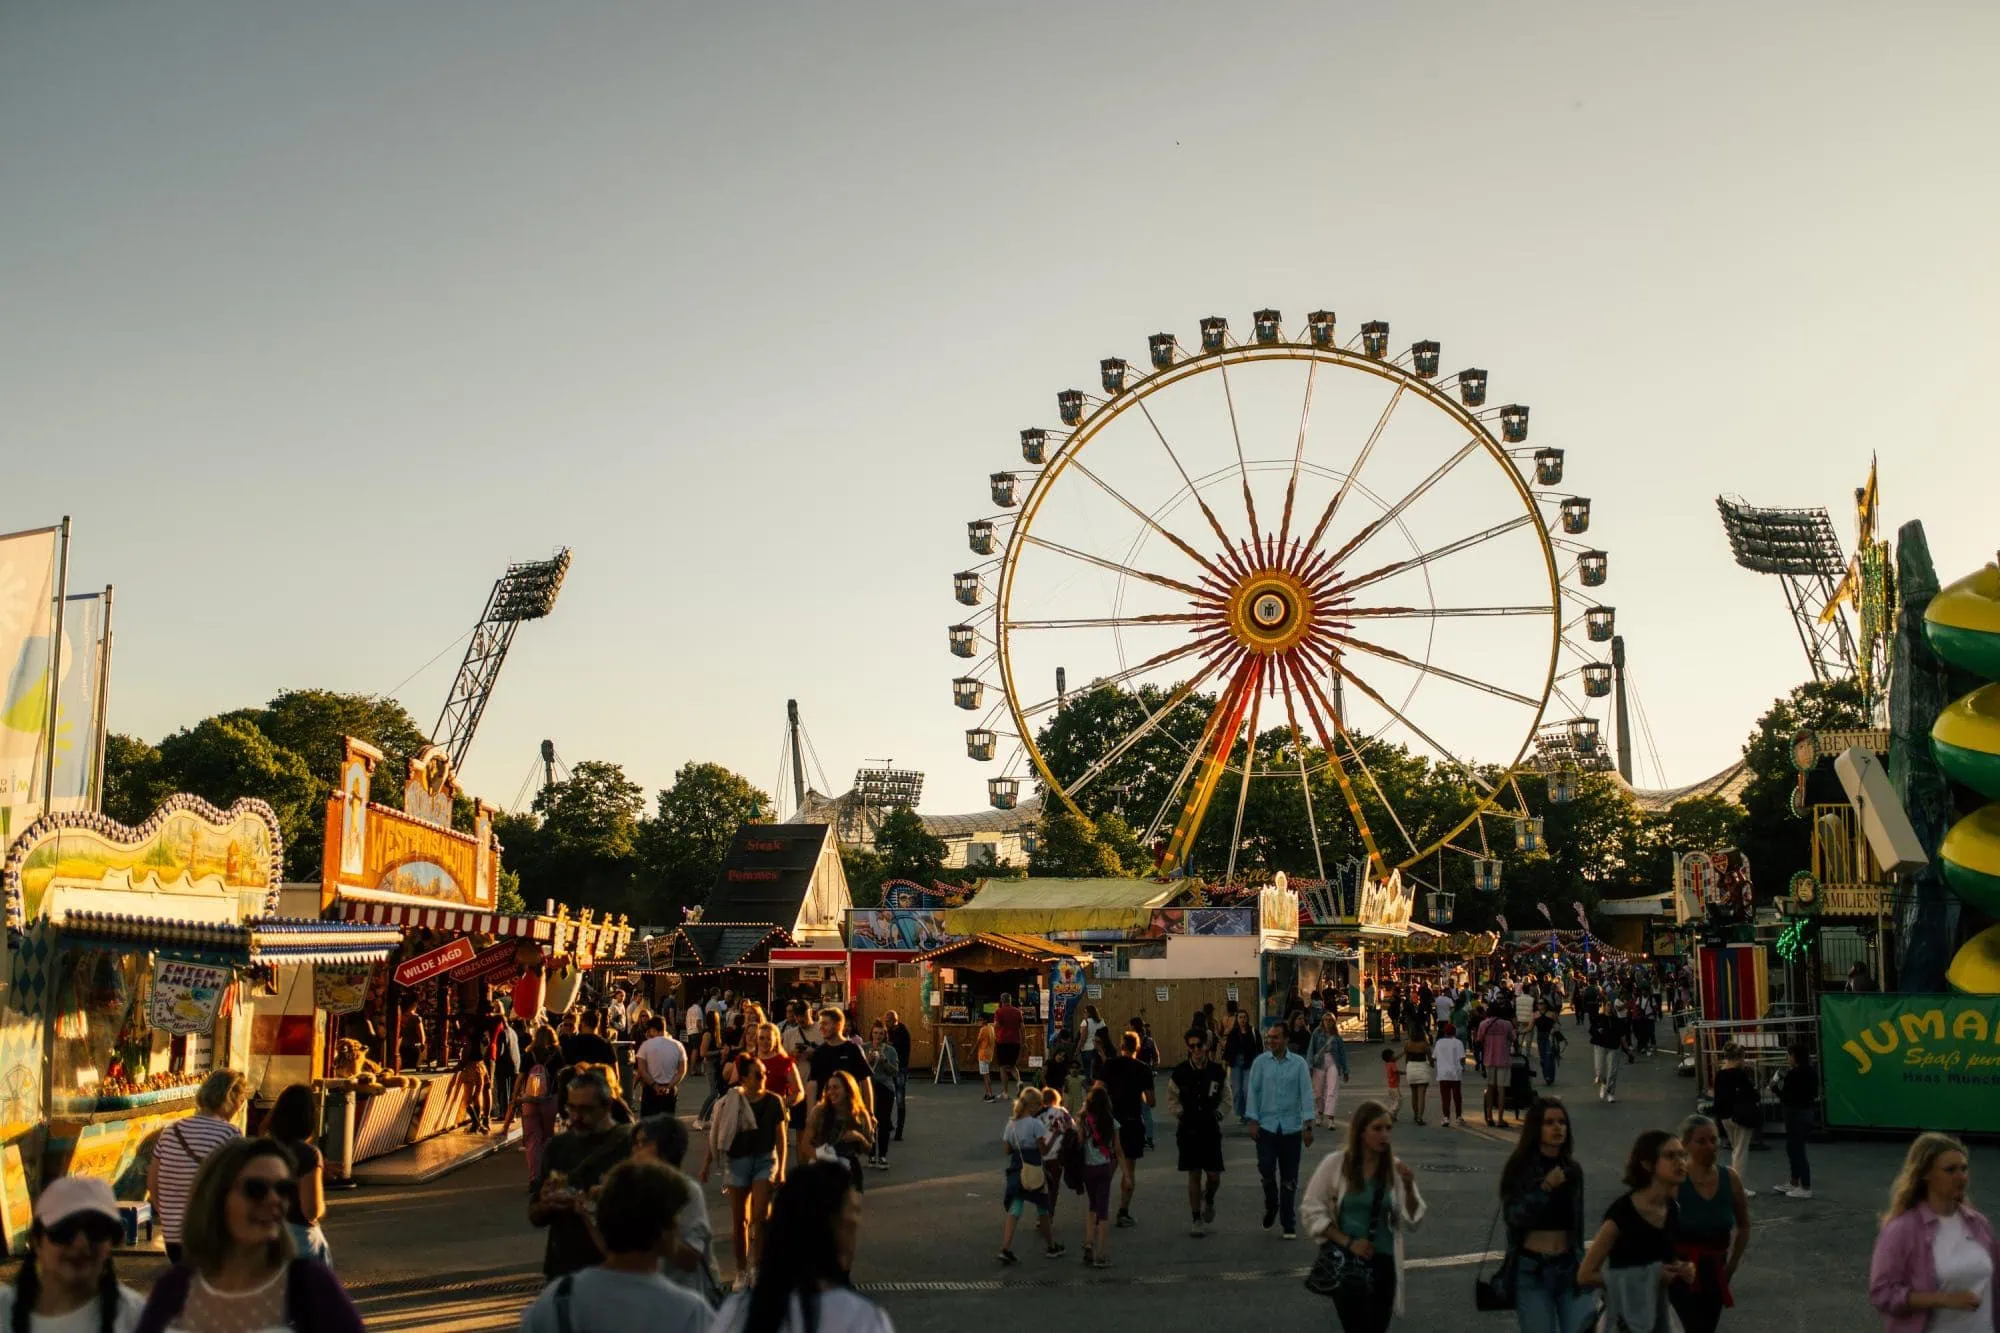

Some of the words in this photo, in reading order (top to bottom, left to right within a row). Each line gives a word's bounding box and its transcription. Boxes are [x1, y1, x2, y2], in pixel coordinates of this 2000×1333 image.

[747, 840, 782, 850] Steak
[728, 869, 778, 881] Pommes
[403, 959, 437, 980] WILDE
[437, 948, 463, 966] JAGD
[159, 974, 221, 990] ANGELN
[1842, 1009, 2000, 1074] JUMA
[1904, 1047, 1961, 1072] Spaß
